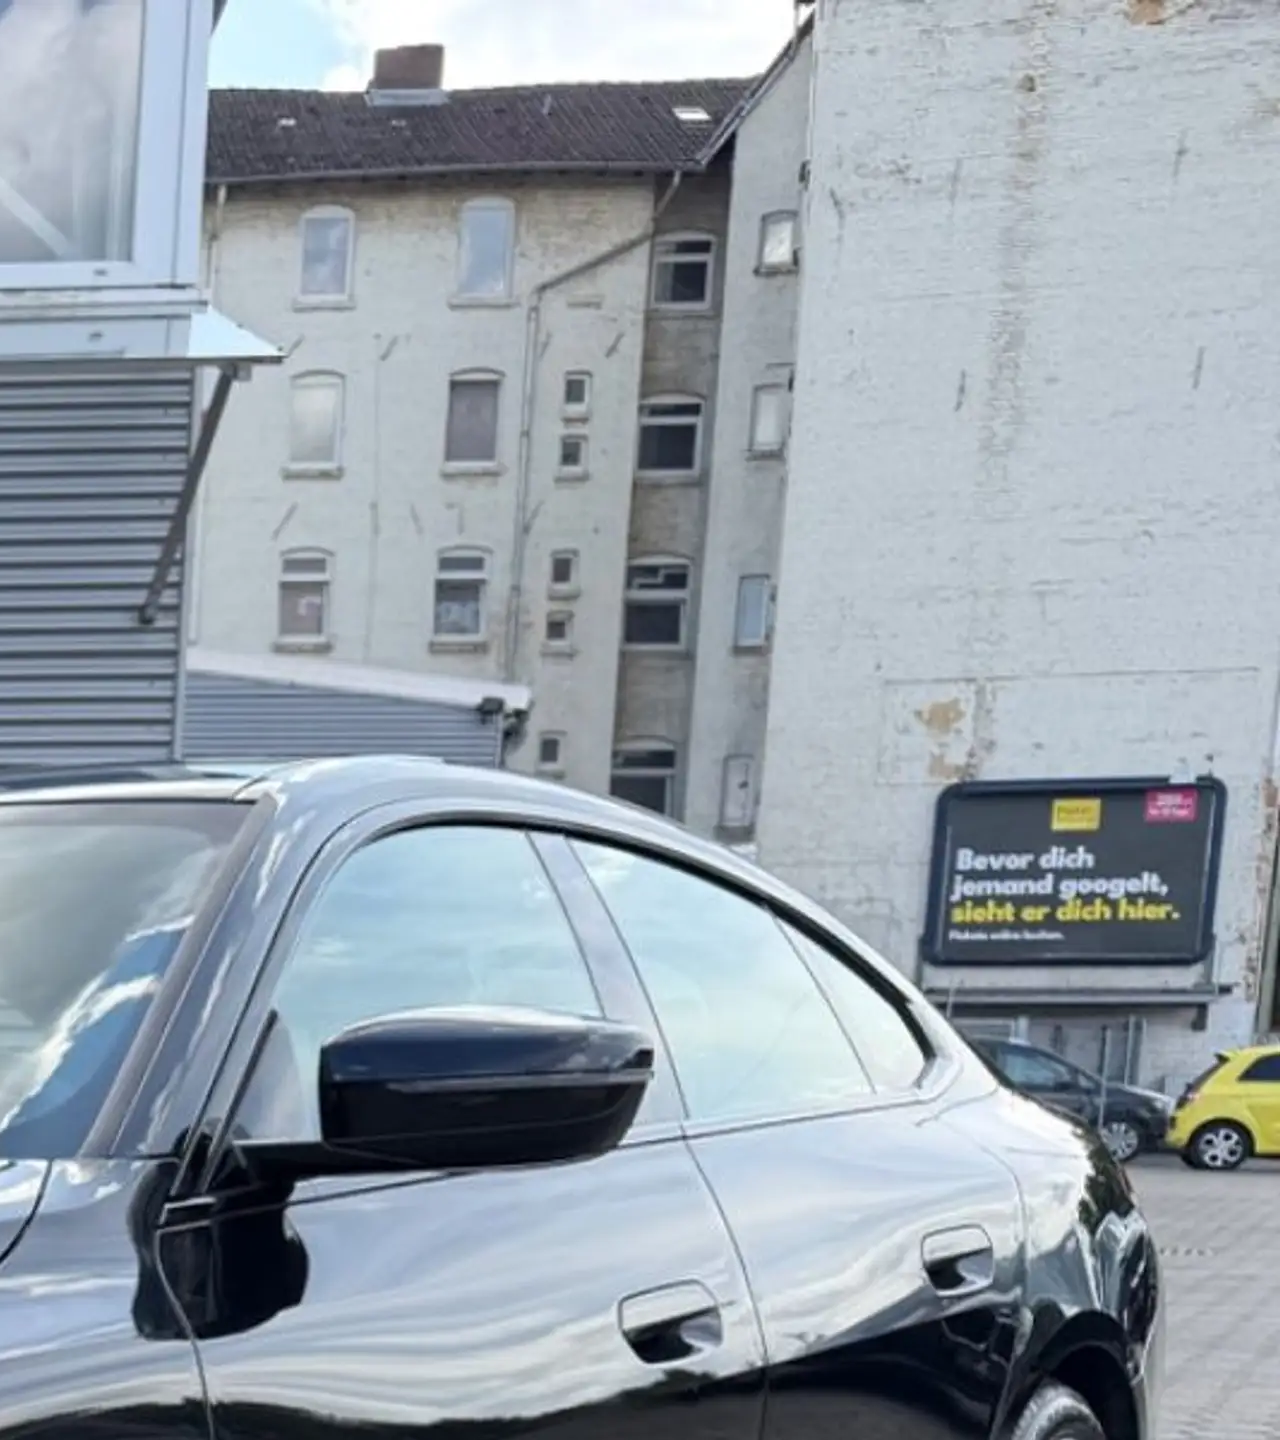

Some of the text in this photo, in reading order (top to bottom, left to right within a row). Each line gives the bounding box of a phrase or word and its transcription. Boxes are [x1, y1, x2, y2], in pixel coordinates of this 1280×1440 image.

[956, 846, 1094, 870] Bevor dich
[951, 872, 1169, 901] jemand googelt,
[950, 896, 1181, 923] sieht er dich hier.
